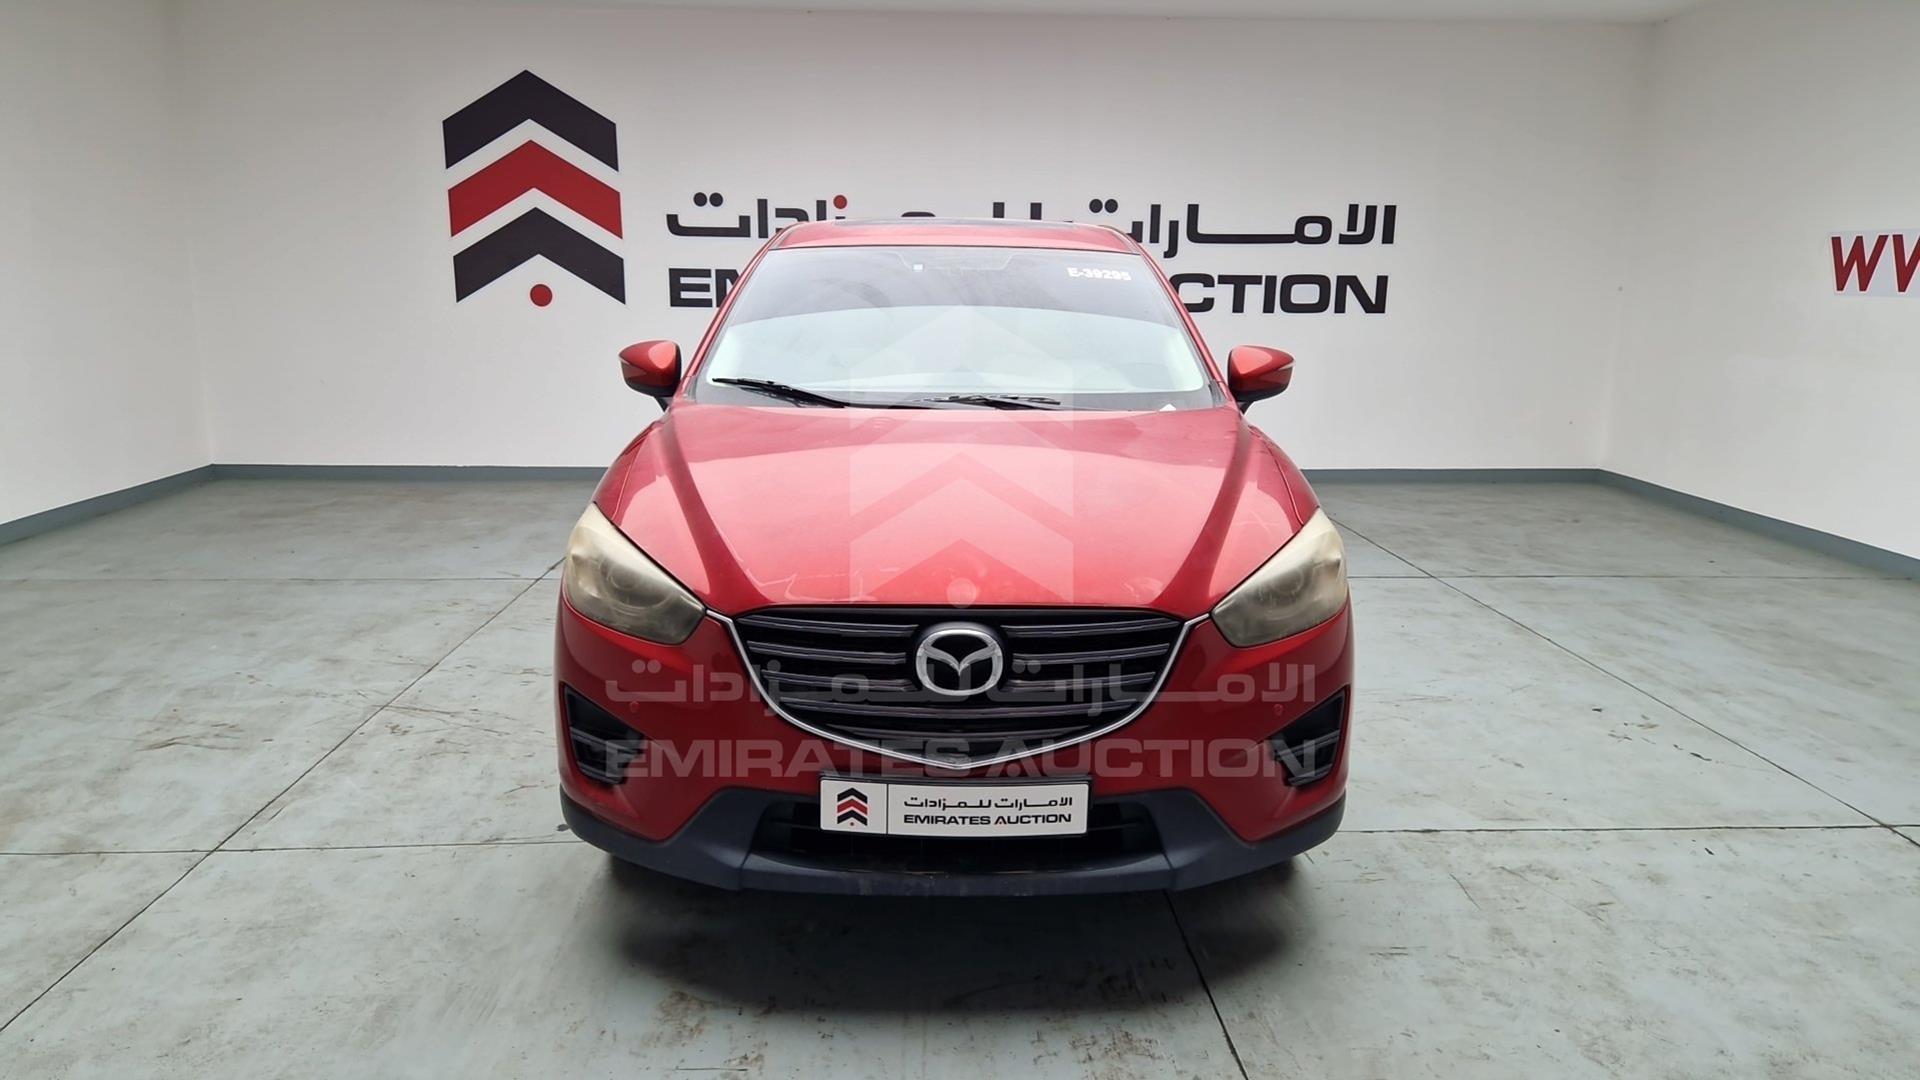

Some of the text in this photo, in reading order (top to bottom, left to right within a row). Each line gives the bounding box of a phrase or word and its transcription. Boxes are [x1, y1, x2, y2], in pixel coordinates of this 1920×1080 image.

[1168, 272, 1389, 315] CTION
[904, 797, 1072, 811] الامارات للمزادات
[903, 813, 1072, 825] EMIRATES AUCTION
